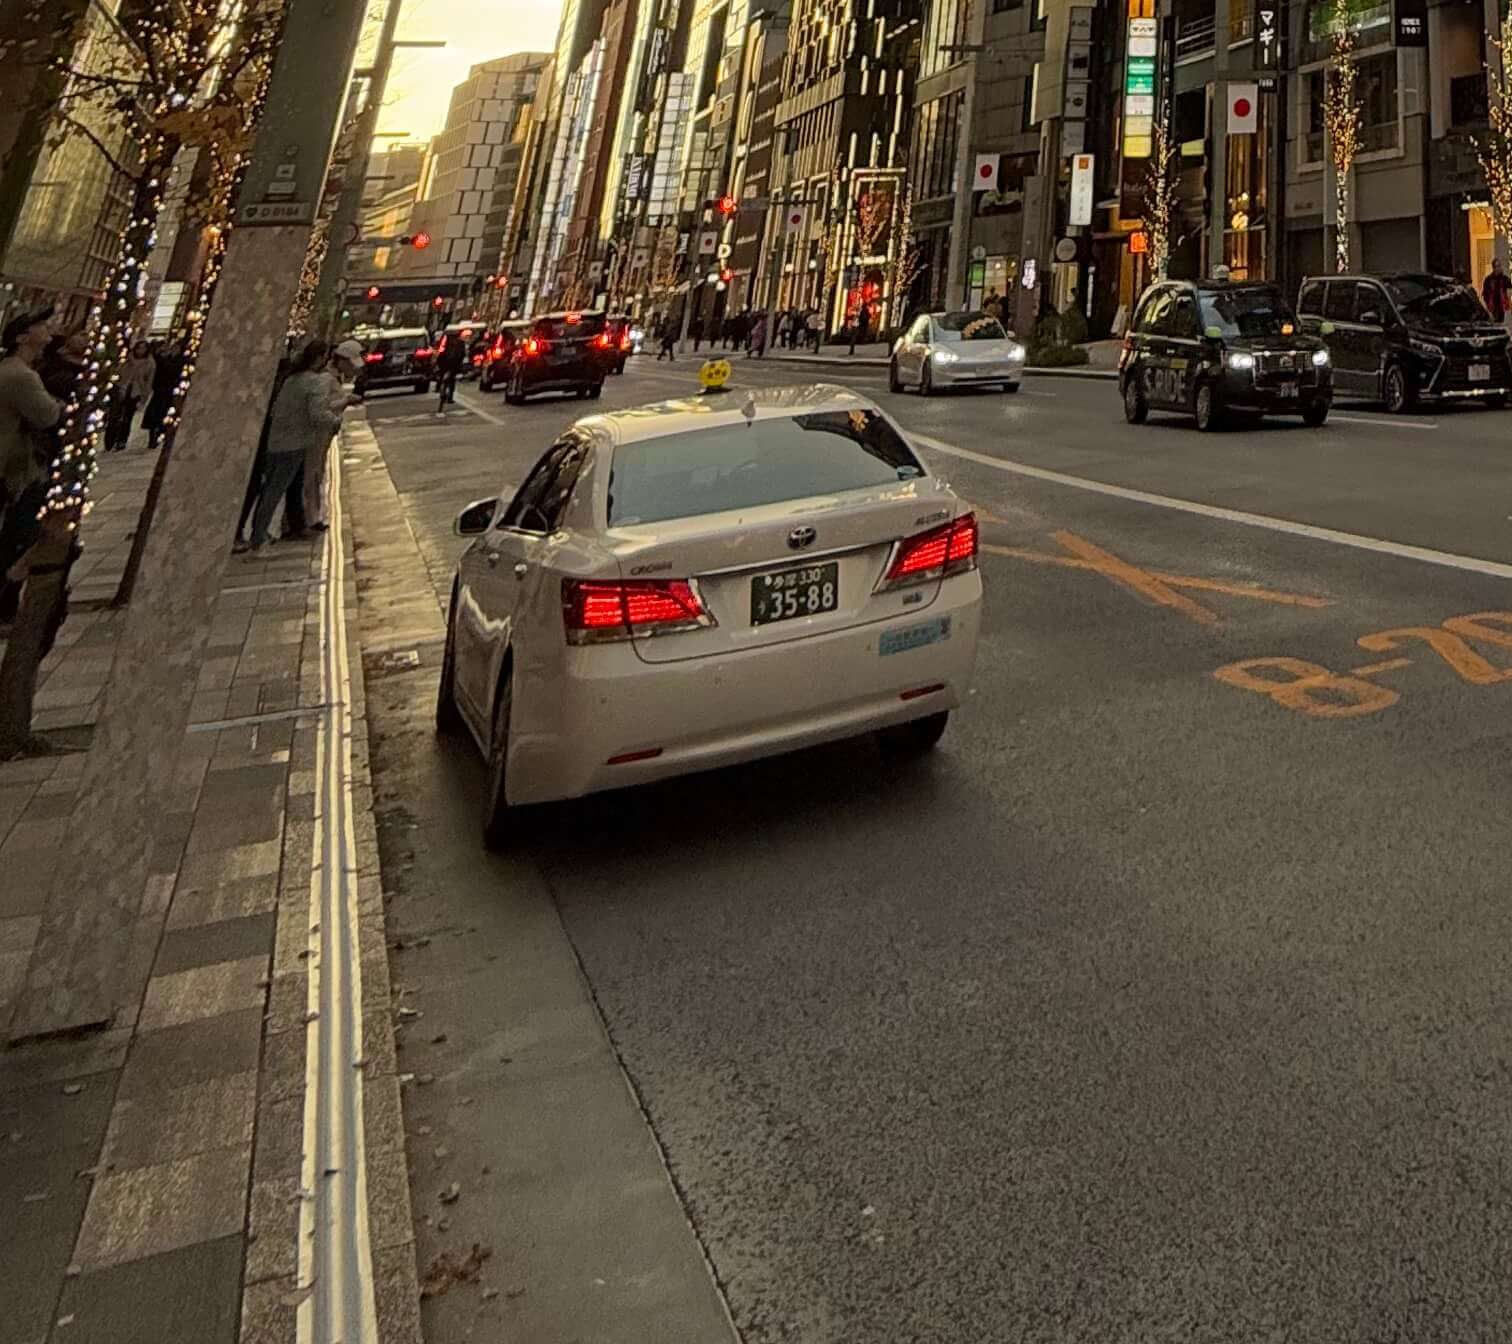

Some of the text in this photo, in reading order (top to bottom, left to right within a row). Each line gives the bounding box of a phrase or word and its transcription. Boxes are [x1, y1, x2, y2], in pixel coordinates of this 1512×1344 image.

[1260, 10, 1275, 65] マギー
[769, 581, 834, 620] 35-88
